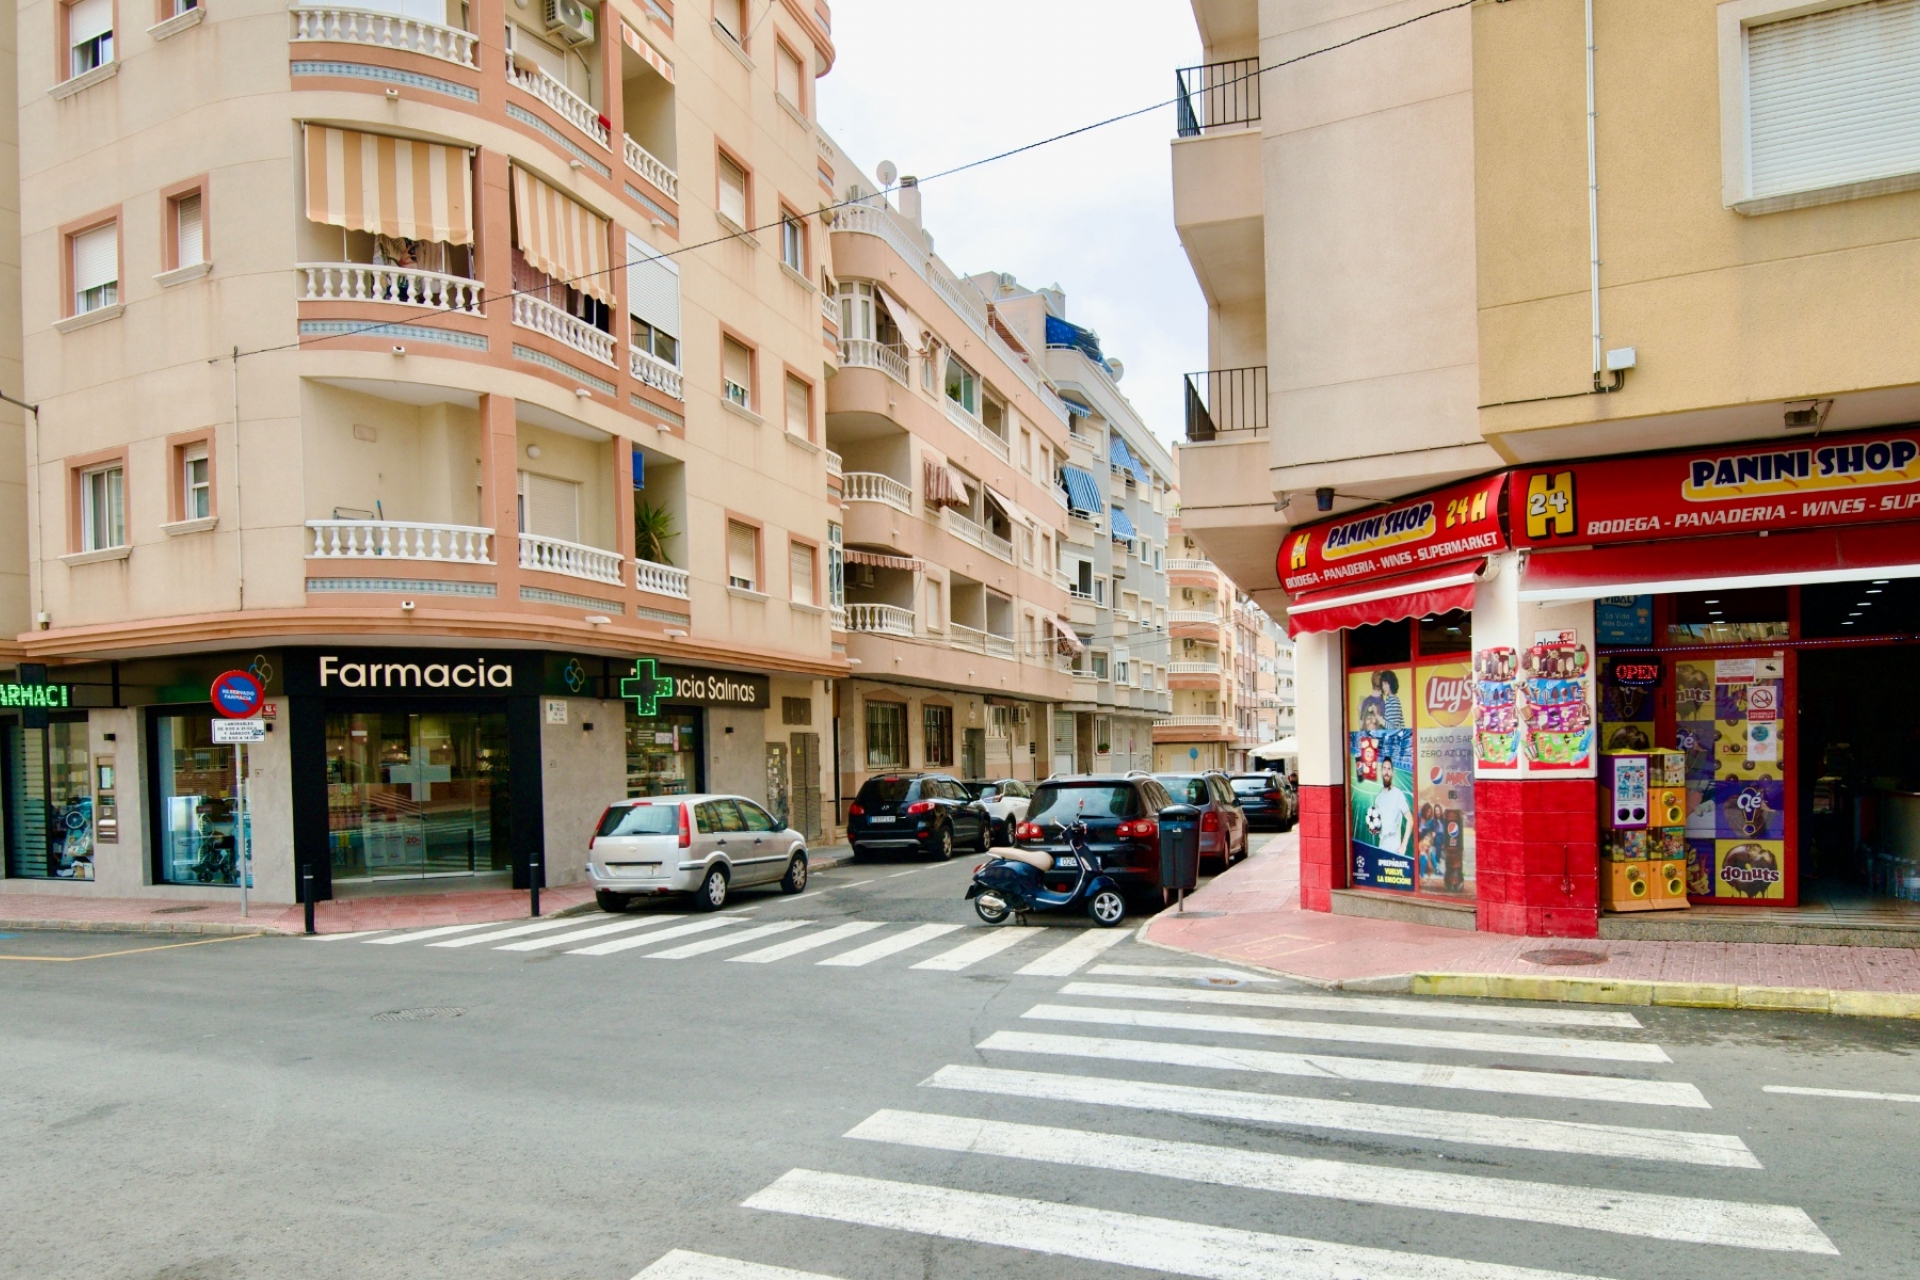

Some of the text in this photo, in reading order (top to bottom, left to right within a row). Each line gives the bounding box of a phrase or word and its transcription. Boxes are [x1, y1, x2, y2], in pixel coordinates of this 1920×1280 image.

[1692, 440, 1917, 487] PANINI SHOP
[1445, 491, 1489, 529] 24 H
[1527, 471, 1575, 538] H
[1530, 491, 1568, 516] 24
[1587, 516, 1660, 535] BODEGA
[1674, 505, 1786, 528] PANADERIA
[1802, 498, 1867, 517] WINES
[1327, 503, 1433, 549] PANINI SHOP
[1285, 572, 1319, 589] BODEGA
[1323, 560, 1376, 580] PANADERIA
[1380, 551, 1412, 568] WINES
[1417, 531, 1498, 561] SUPERMARKET
[319, 656, 512, 687] Farmacia
[1615, 664, 1658, 679] OPEN
[222, 688, 255, 696] RESERVADO
[708, 676, 755, 702] Salinas
[1429, 674, 1472, 713] Lay's
[1420, 749, 1442, 758] ZERO
[1737, 792, 1761, 812] Qé
[1721, 866, 1780, 882] donuts
